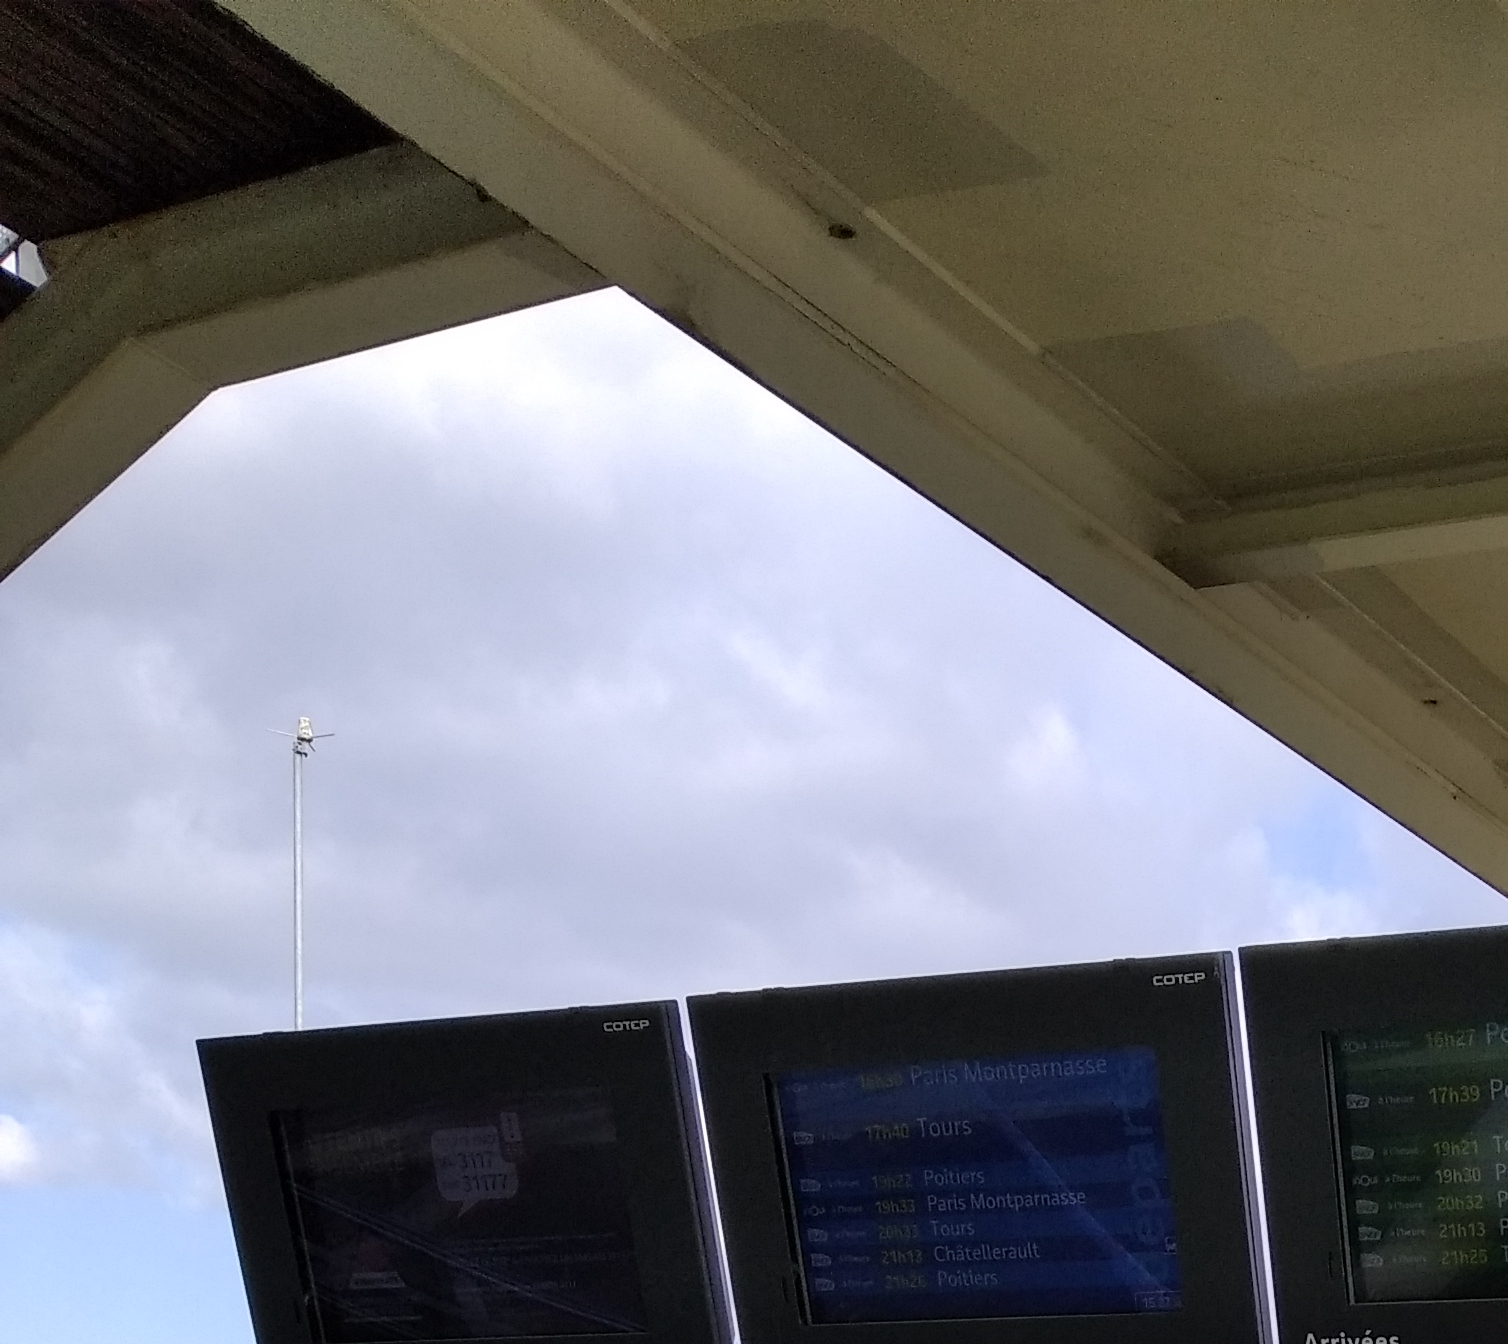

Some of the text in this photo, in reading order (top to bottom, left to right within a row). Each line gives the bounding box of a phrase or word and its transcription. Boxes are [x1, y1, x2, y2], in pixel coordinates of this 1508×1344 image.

[1152, 971, 1206, 986] COTEP
[603, 1020, 650, 1032] COTEP
[910, 1063, 959, 1087] Paris
[964, 1057, 1108, 1084] Montparnasse
[1428, 1084, 1481, 1104] 17h39
[917, 1116, 973, 1137] Tours
[1433, 1139, 1479, 1157] 19h21
[923, 1169, 985, 1186] Poitiers
[1435, 1168, 1481, 1184] 19h30
[927, 1194, 966, 1212] Paris
[970, 1189, 1086, 1211] Montparnasse
[1437, 1195, 1483, 1211] 20h32
[931, 1220, 975, 1237] Tours
[1439, 1222, 1486, 1239] 21h13
[934, 1241, 1040, 1263] Châtellerault
[938, 1270, 998, 1287] Poitiers
